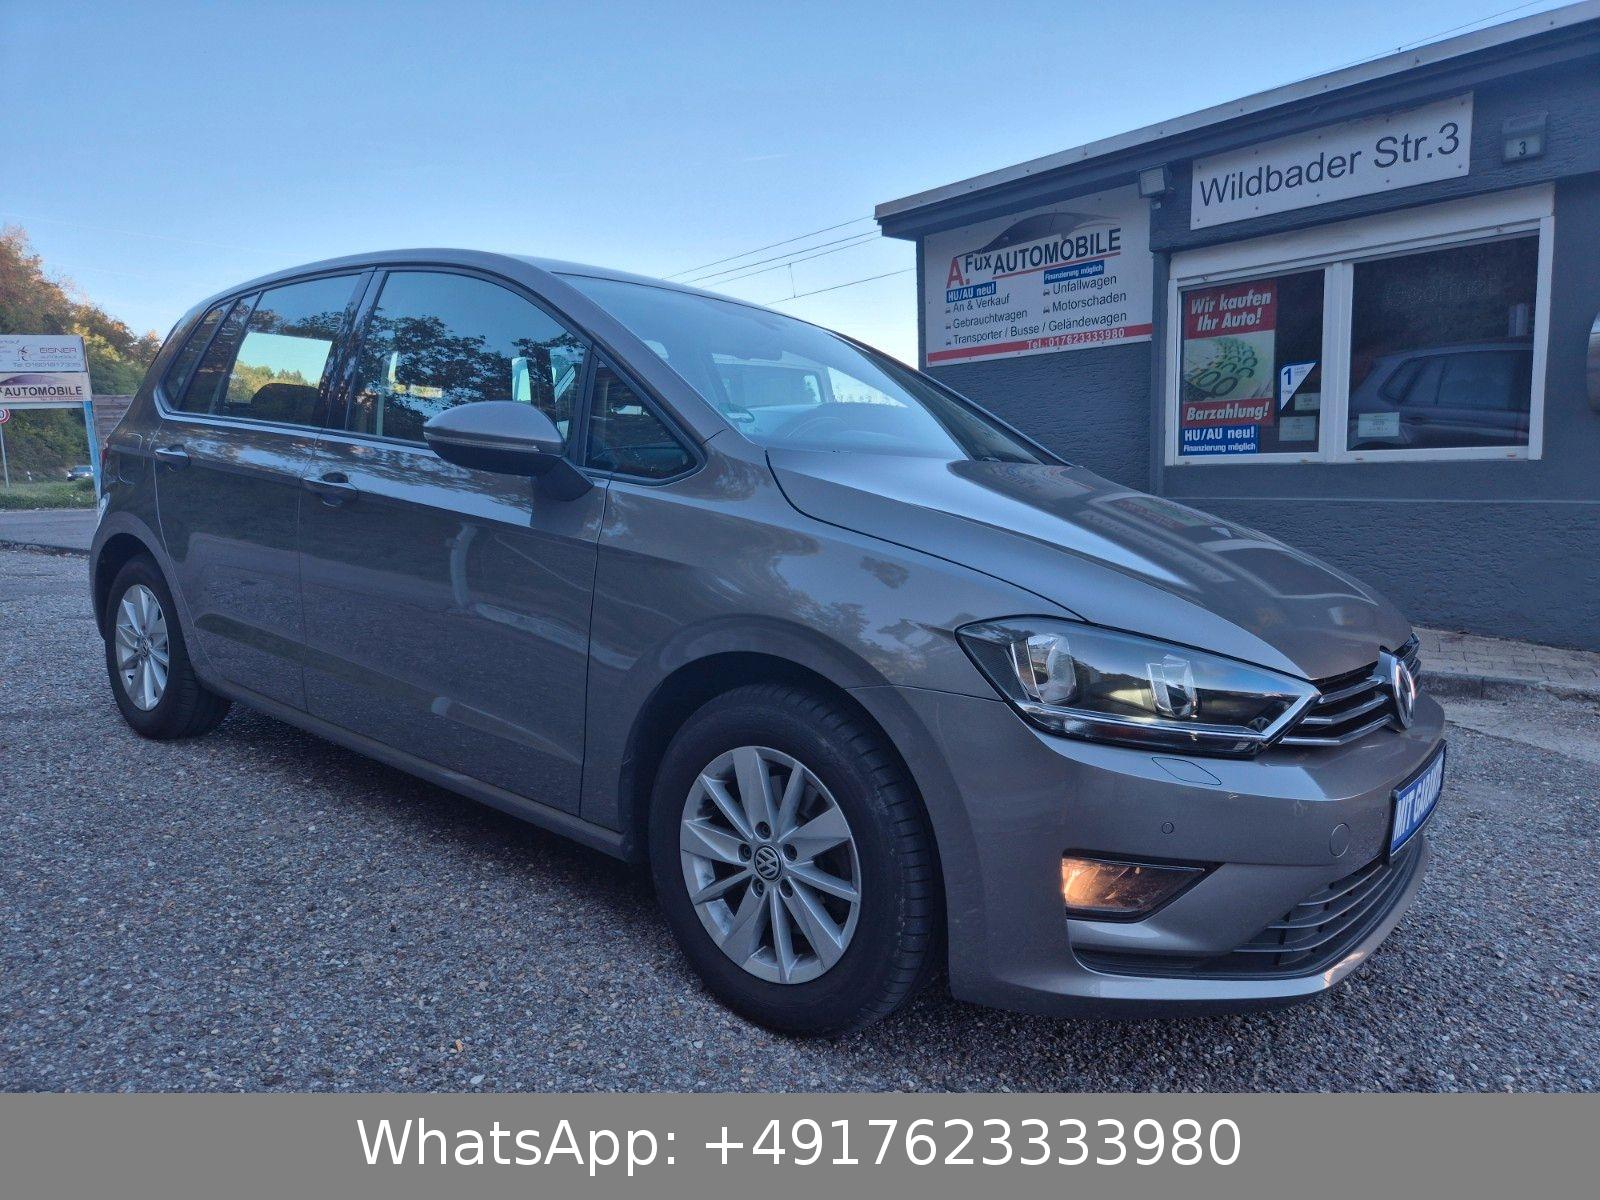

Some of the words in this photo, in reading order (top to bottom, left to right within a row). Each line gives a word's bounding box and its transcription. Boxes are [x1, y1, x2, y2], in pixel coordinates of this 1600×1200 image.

[1518, 140, 1527, 156] 3
[1200, 150, 1362, 207] Wildbader
[1373, 121, 1460, 169] Str.3
[965, 252, 992, 274] Fux
[993, 227, 1121, 275] AUTOMOBILE
[948, 287, 974, 302] HU/AU
[1053, 275, 1117, 296] Unfallwagen
[953, 302, 965, 313] An
[967, 300, 974, 311] &
[976, 293, 1011, 309] Verkauf
[1052, 292, 1127, 313] Motorschaden
[1191, 297, 1216, 315] Wir
[1219, 288, 1272, 311] kaufen
[953, 309, 1028, 330] Gebrauchtwagen
[953, 329, 1003, 345] Transporter
[1010, 324, 1040, 338] Busse
[1048, 312, 1127, 332] Geländewagen
[1197, 314, 1219, 332] Ihr
[1221, 307, 1263, 329] Auto!
[4, 386, 83, 397] AUTOMOBILE
[1186, 401, 1270, 421] Barzahlung!
[1184, 427, 1223, 442] HU/AU
[1227, 425, 1255, 440] neu!
[1183, 444, 1227, 453] Finanzierung
[1227, 442, 1256, 453] möglich
